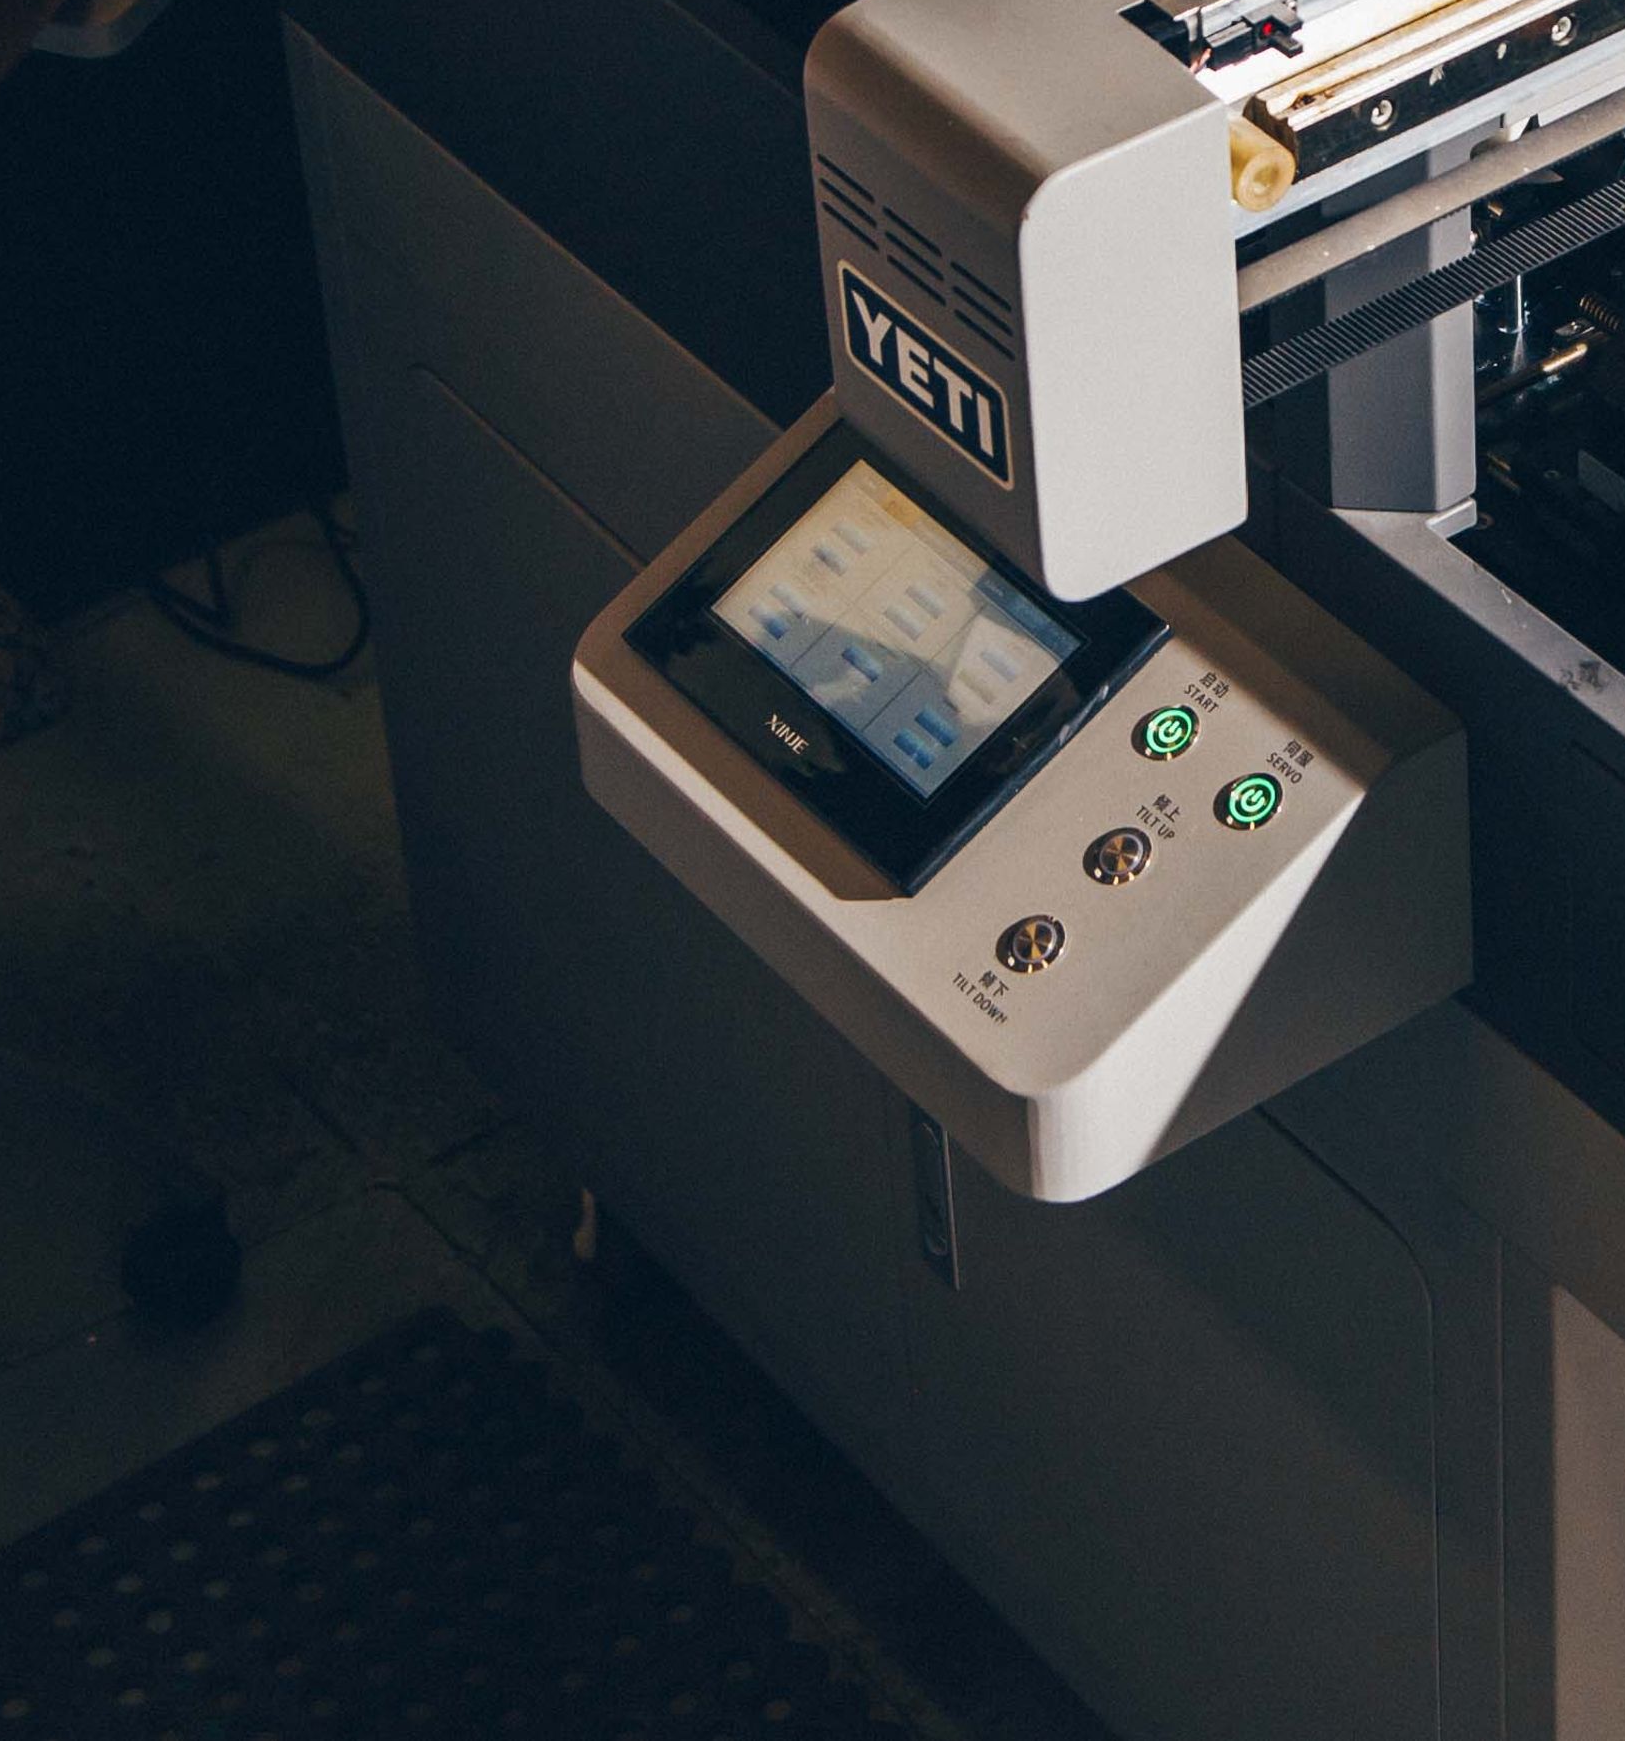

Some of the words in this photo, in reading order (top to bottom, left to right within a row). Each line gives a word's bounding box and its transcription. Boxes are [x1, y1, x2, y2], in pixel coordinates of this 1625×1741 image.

[852, 288, 994, 458] YETI
[1184, 684, 1219, 713] START
[1199, 672, 1230, 699] 启动
[765, 714, 809, 754] XINJE
[1266, 752, 1303, 784] SERVO
[1136, 805, 1161, 828] TILT
[1157, 824, 1176, 840] UP
[953, 972, 976, 996] TILT
[972, 992, 1008, 1024] DOWN
